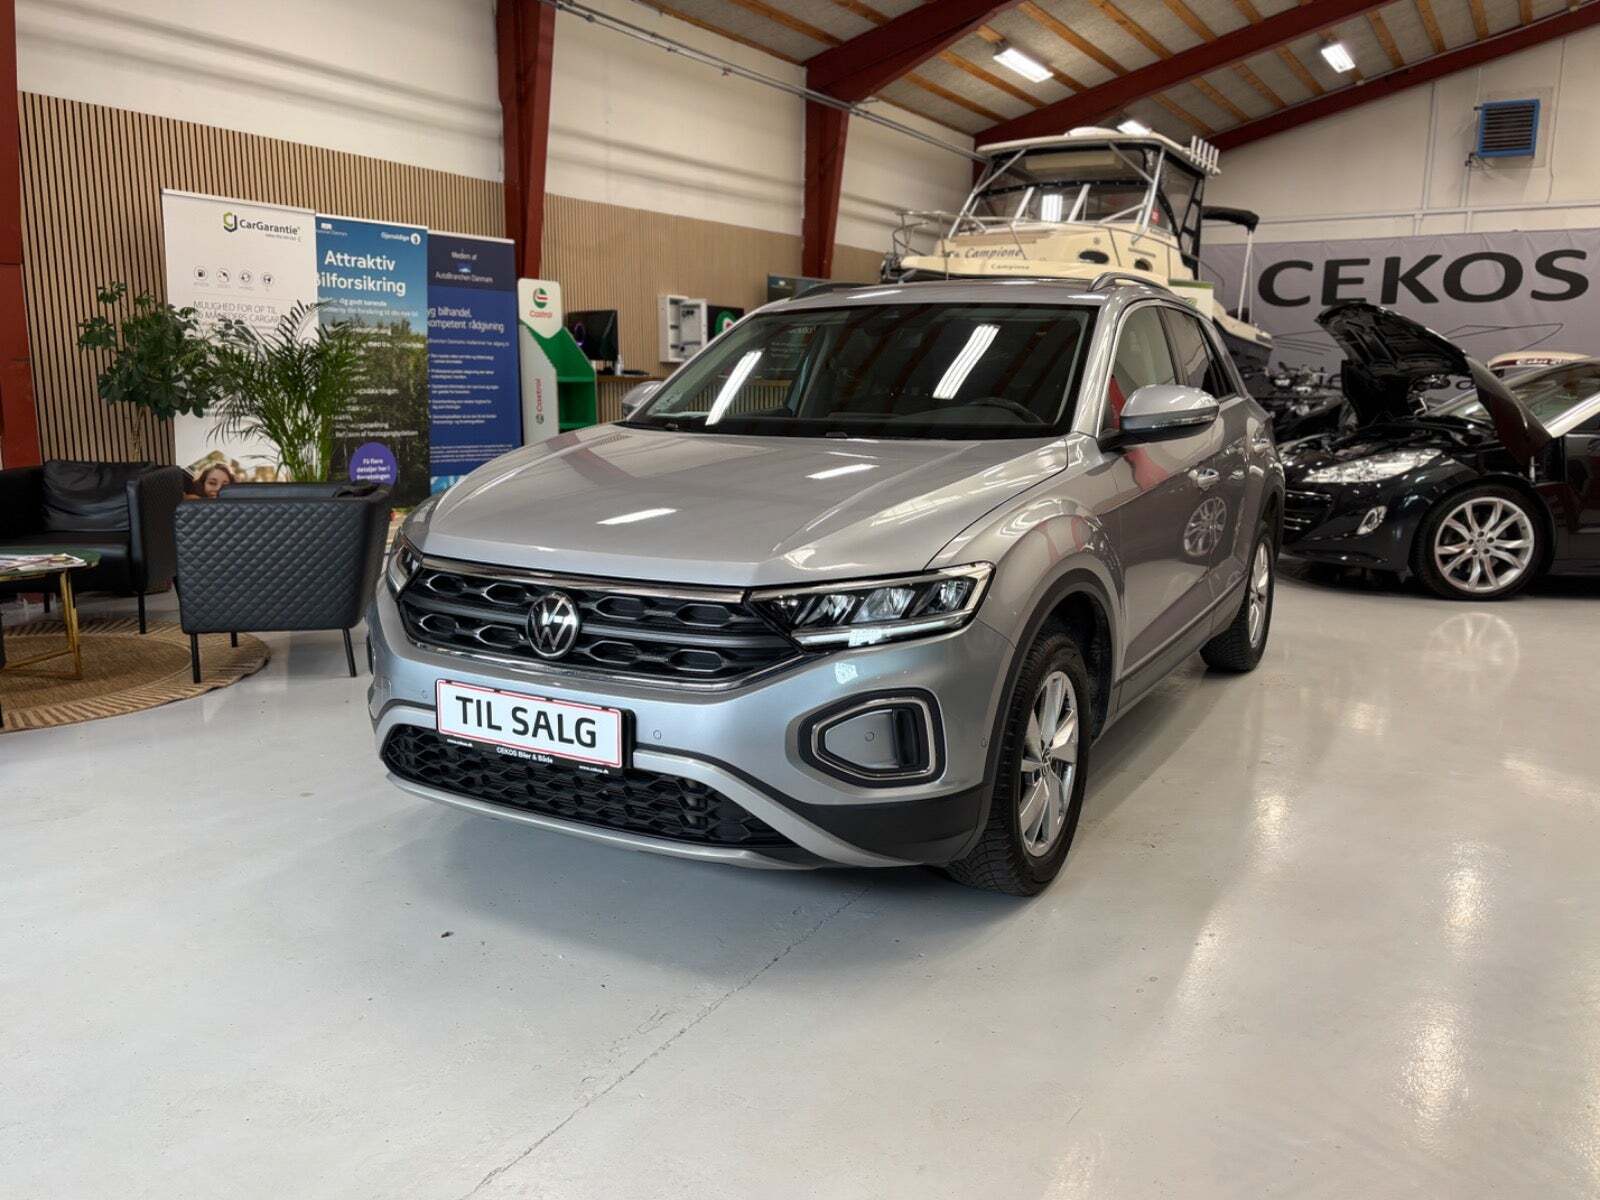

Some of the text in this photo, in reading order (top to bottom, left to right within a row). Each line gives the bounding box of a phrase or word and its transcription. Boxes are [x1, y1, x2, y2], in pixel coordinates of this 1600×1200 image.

[240, 219, 298, 236] CarGarantie
[324, 250, 396, 271] Attraktiv
[1257, 249, 1589, 308] CEKOS
[237, 303, 253, 313] FOR
[455, 695, 597, 749] TIL SALG
[496, 746, 517, 757] CEKOS
[518, 750, 531, 760] Biler
